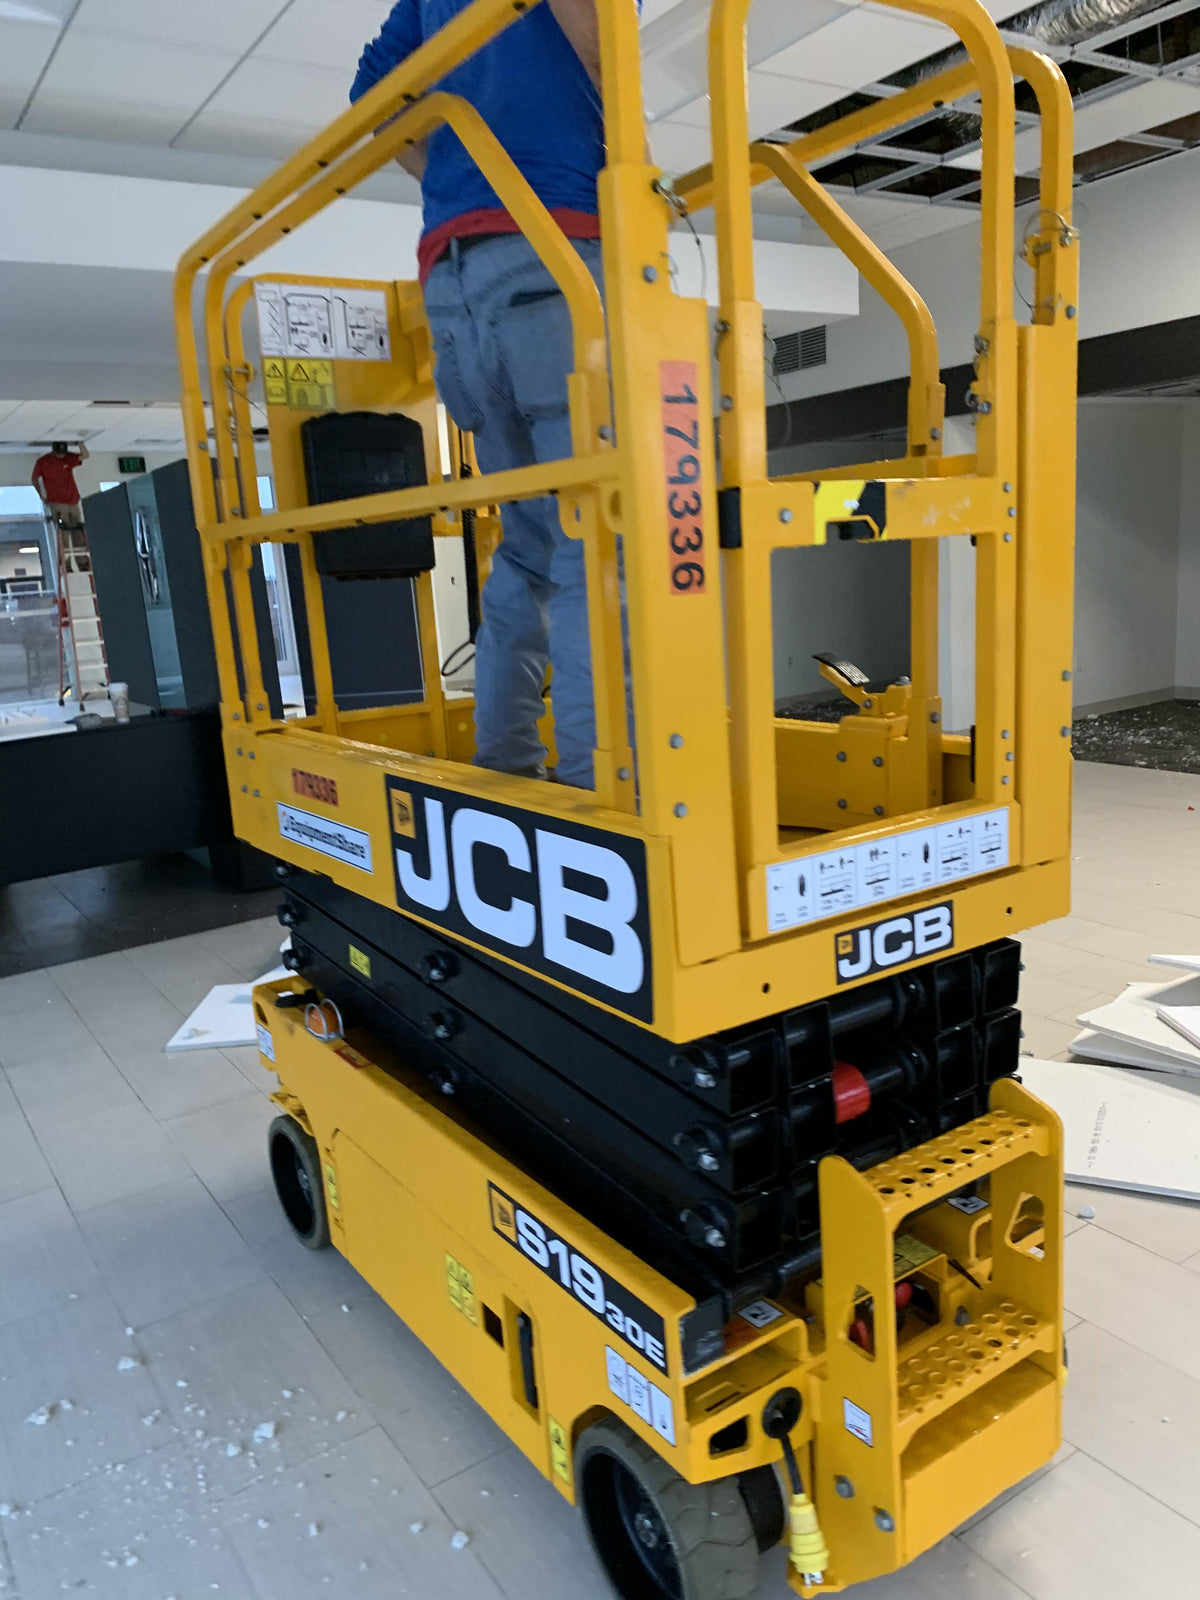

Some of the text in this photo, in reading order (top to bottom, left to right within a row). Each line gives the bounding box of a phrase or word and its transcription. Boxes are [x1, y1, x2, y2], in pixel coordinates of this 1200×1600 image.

[664, 383, 705, 592] 179336
[396, 797, 645, 994] JCB
[838, 906, 953, 978] JCB
